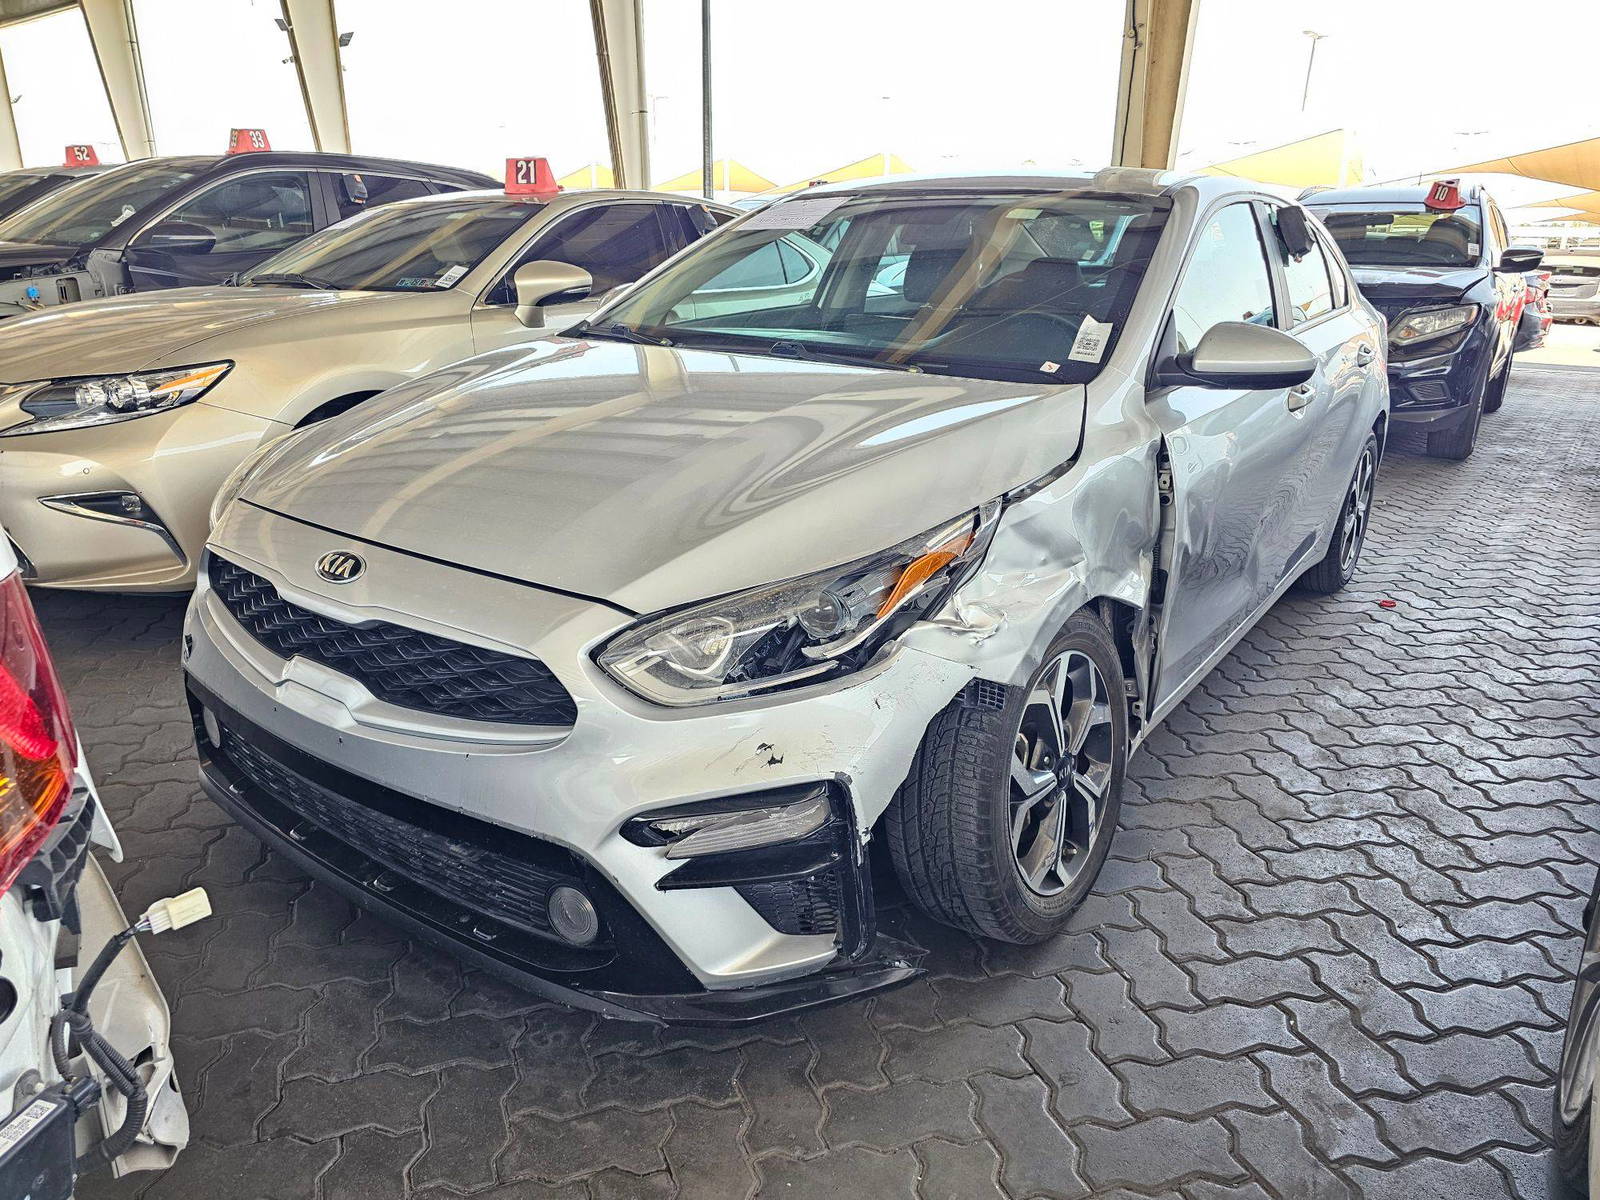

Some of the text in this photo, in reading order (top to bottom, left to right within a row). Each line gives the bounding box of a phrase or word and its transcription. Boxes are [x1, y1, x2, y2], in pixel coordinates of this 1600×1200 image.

[250, 130, 265, 148] 33
[74, 147, 90, 161] 52
[517, 160, 536, 184] 21
[1434, 185, 1449, 201] 10
[319, 553, 356, 578] KIA
